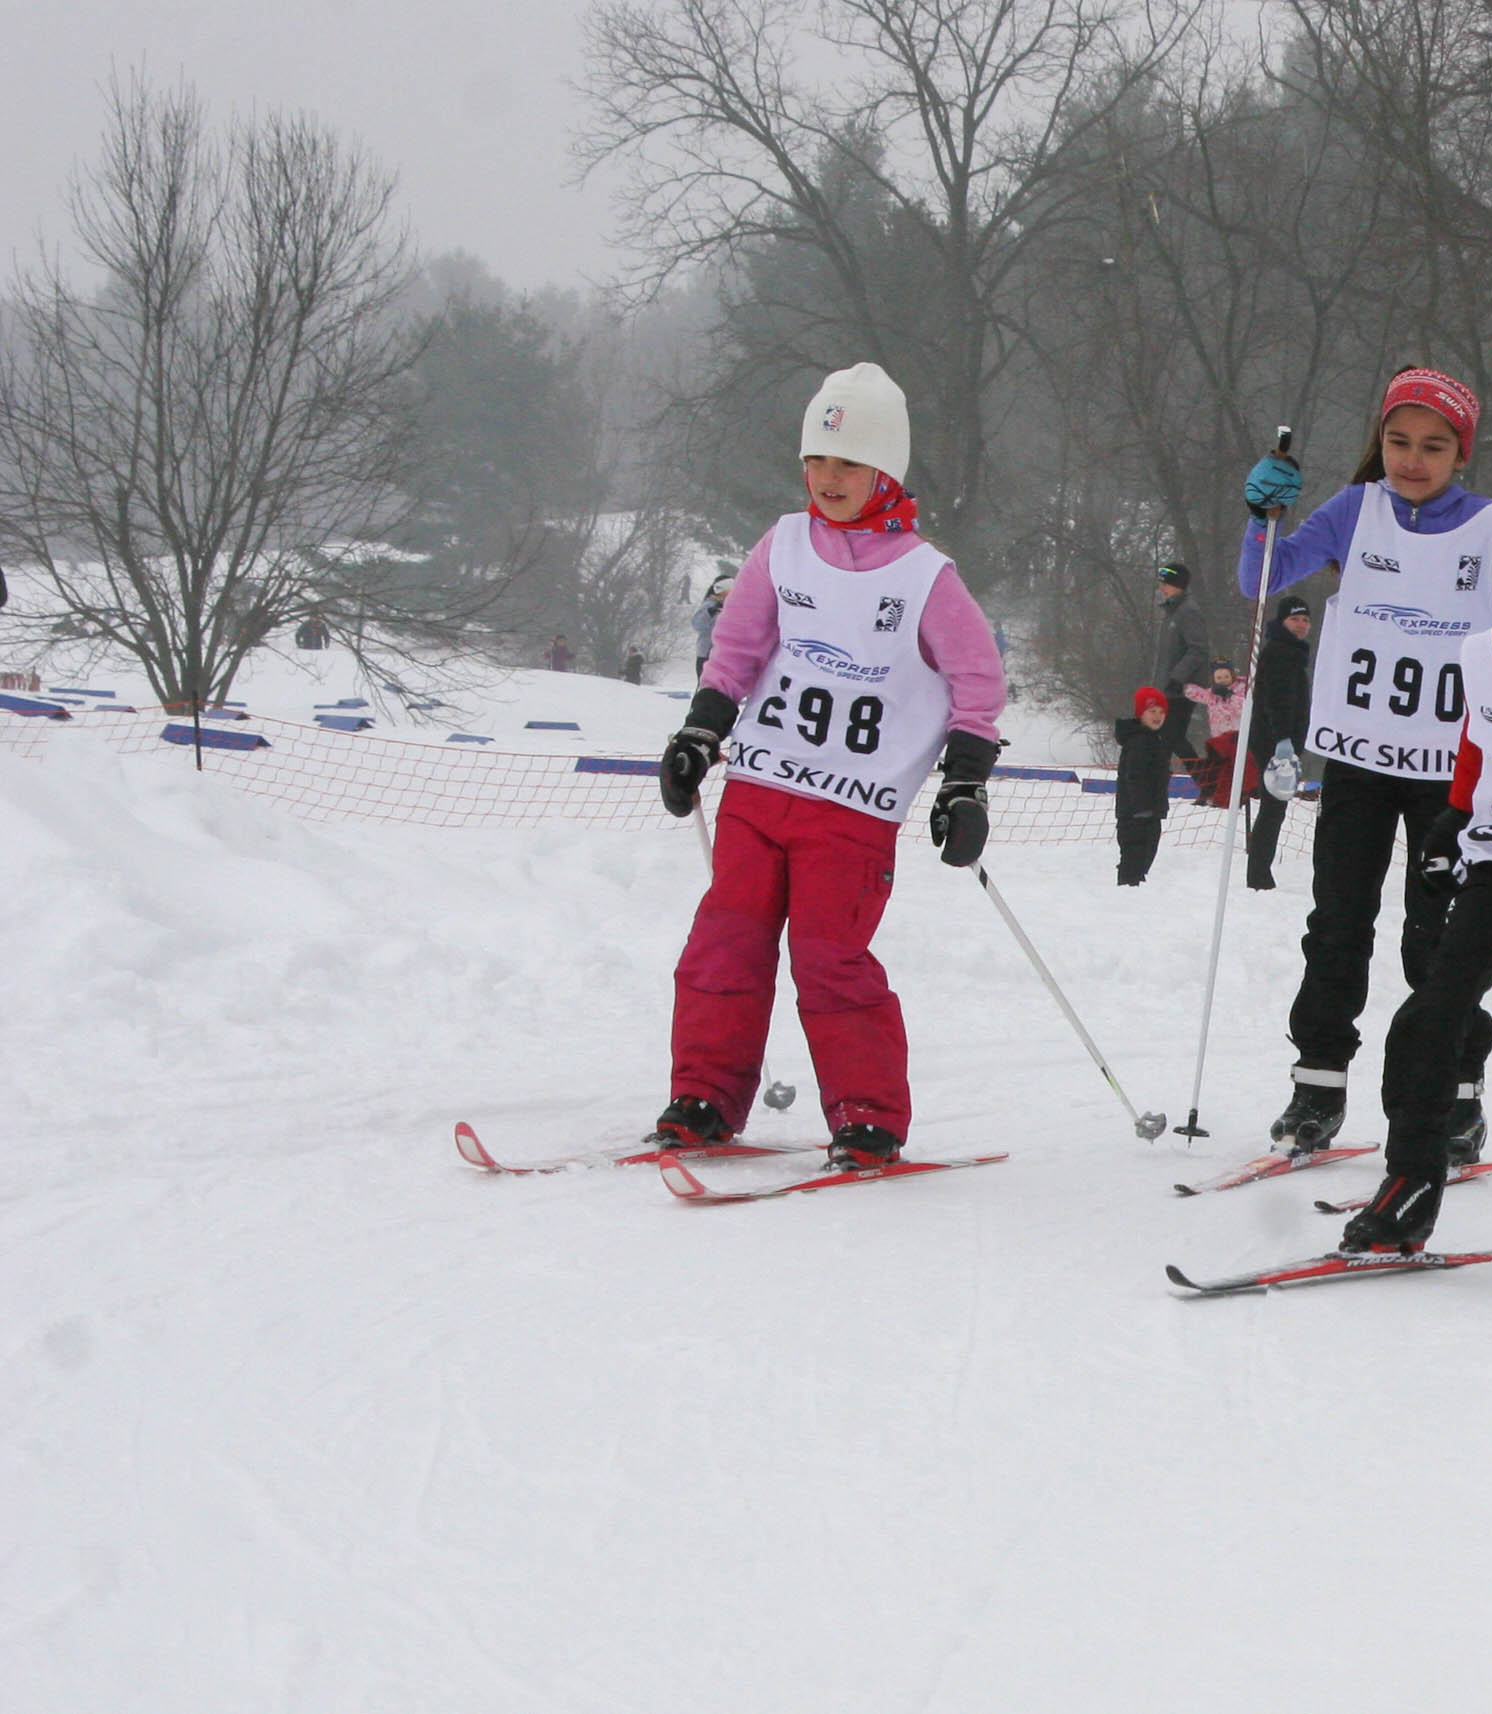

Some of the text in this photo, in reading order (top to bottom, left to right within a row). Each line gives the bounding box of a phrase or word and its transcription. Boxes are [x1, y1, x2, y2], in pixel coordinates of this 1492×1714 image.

[1354, 606, 1471, 630] LAKE EXPRESS
[815, 654, 891, 676] EXPRESS
[1346, 647, 1465, 723] 290
[757, 675, 884, 755] 298
[1314, 727, 1370, 762] CXC
[772, 759, 897, 811] SKIING
